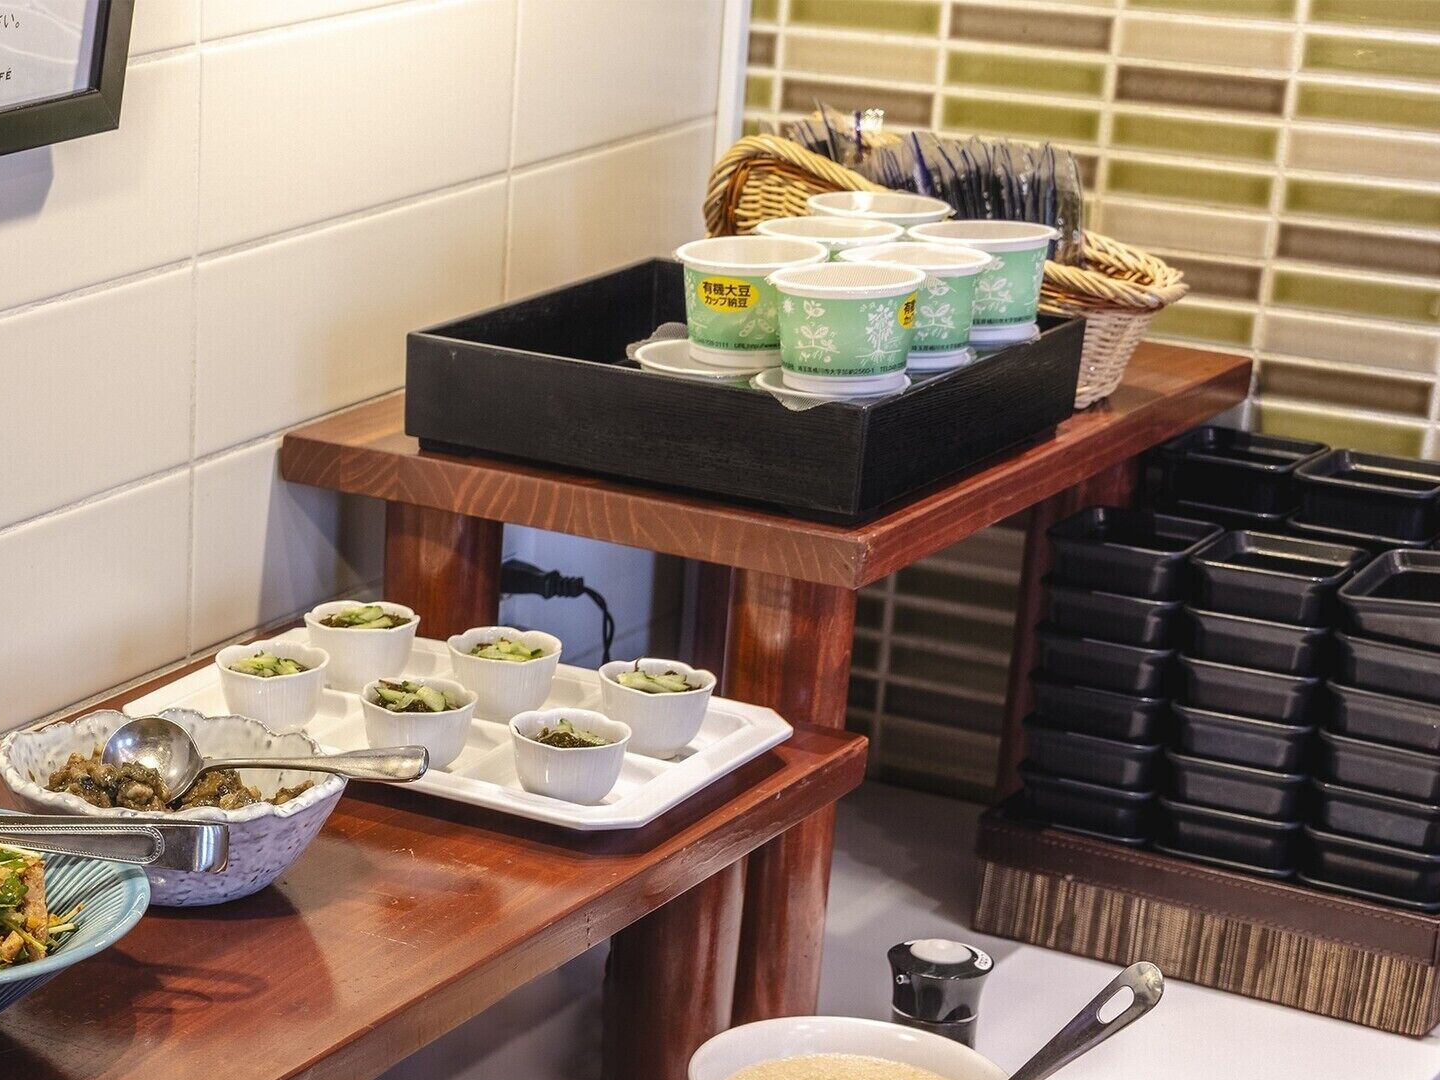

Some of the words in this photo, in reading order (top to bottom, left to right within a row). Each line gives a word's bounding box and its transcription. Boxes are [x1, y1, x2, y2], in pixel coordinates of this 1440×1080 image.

[702, 281, 751, 297] 有機大豆
[704, 295, 748, 308] カップ納豆
